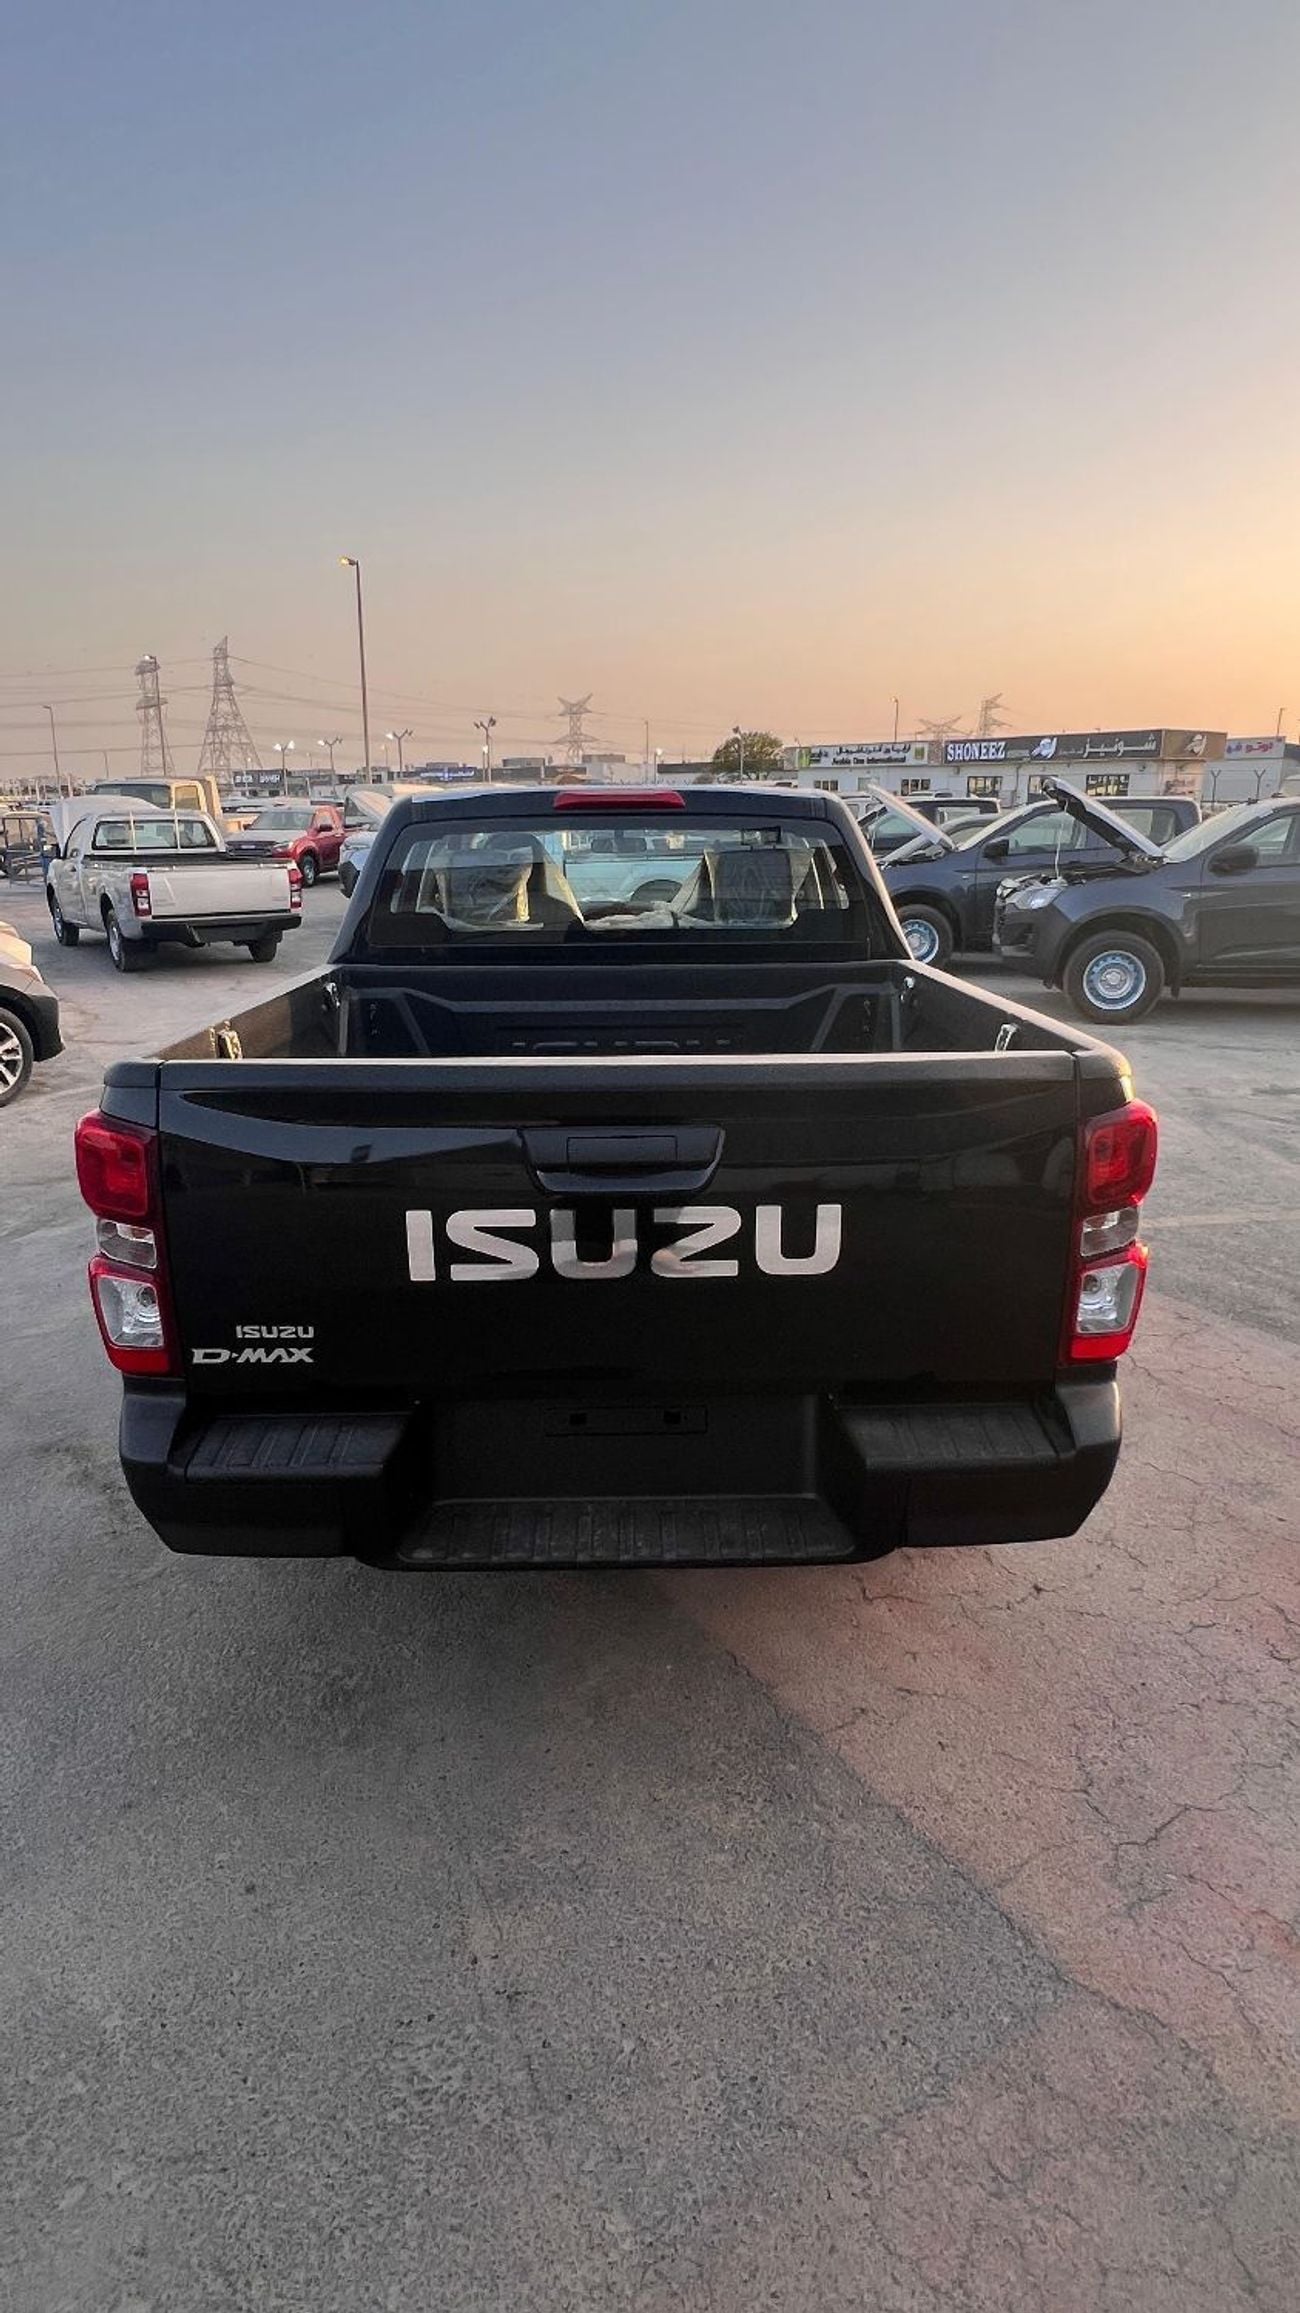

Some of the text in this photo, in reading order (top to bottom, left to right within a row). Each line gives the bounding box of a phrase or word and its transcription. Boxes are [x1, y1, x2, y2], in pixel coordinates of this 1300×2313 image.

[946, 741, 1006, 760] SHONEEZ
[405, 1204, 842, 1281] ISUZU
[235, 1325, 314, 1338] ISUZU
[192, 1347, 314, 1364] D-MAX
